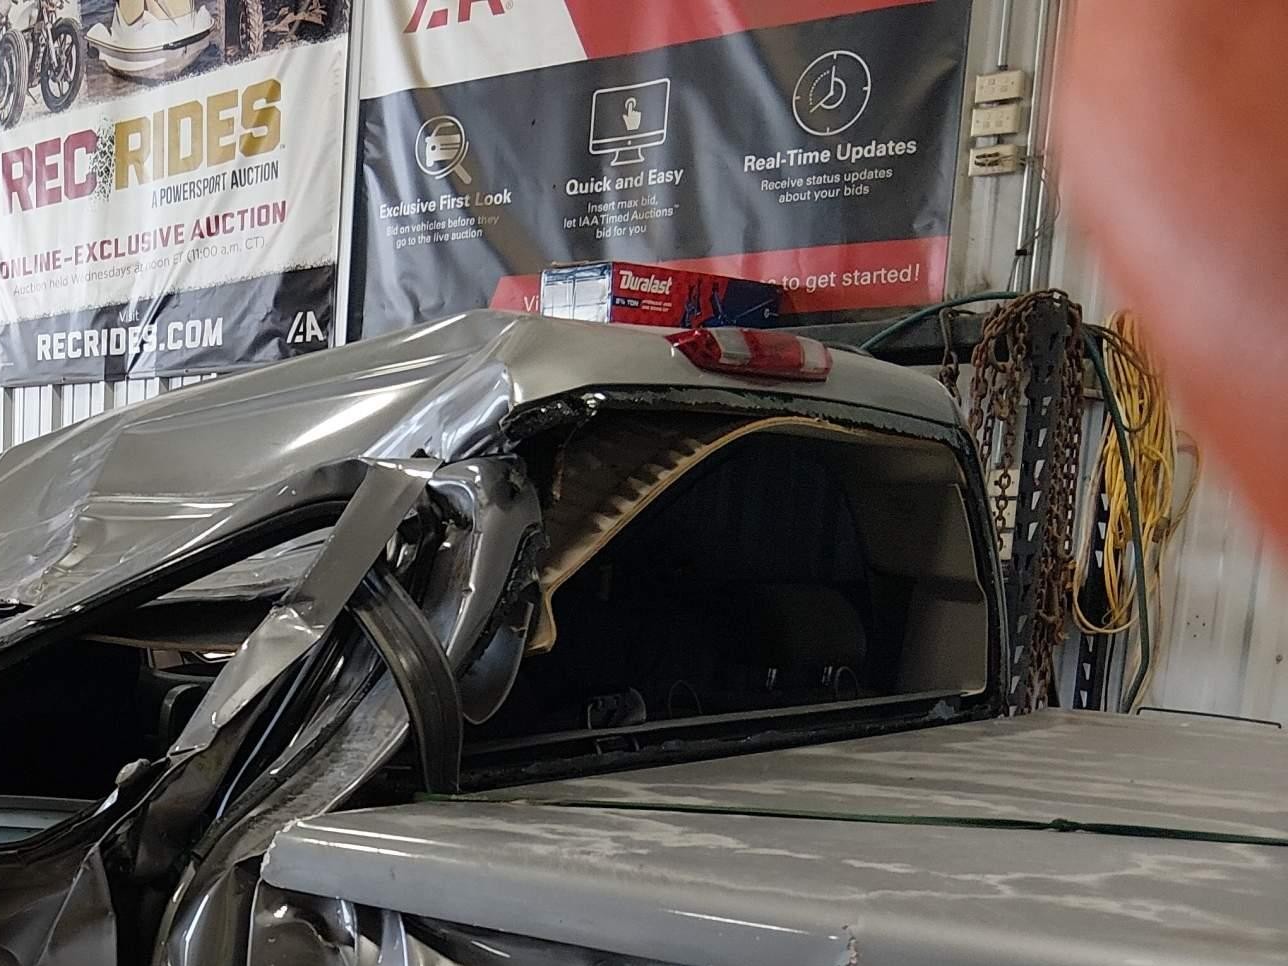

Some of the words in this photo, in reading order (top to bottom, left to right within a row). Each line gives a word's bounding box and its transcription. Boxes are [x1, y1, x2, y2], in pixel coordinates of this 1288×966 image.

[2, 129, 99, 214] REC
[115, 79, 282, 190] RIDES
[743, 148, 831, 173] Real-Time
[835, 139, 918, 164] Updates
[152, 190, 159, 208] A
[159, 172, 227, 207] POWERSPORT
[230, 160, 280, 189] AUCTION
[566, 175, 611, 196] Quick
[615, 171, 644, 190] and
[647, 168, 684, 186] Easy
[761, 176, 804, 192] Receive
[806, 172, 841, 186] status
[843, 167, 894, 184] updates
[379, 198, 436, 219] Exclusive
[439, 194, 471, 210] First
[475, 188, 512, 206] Look
[587, 201, 615, 213] Insert
[617, 199, 639, 210] max
[778, 190, 811, 204] about
[813, 187, 841, 202] your
[843, 184, 870, 197] bids
[411, 219, 446, 232] vehicles
[447, 216, 476, 228] before
[477, 214, 500, 227] they
[563, 217, 577, 229] let
[578, 215, 600, 227] IAA
[600, 211, 630, 225] Timed
[595, 227, 611, 239] bid
[613, 225, 627, 236] for
[628, 224, 647, 238] you
[0, 223, 185, 280] ONLINE-EXCLUSIVE
[190, 200, 287, 241] AUCTION
[245, 236, 265, 250] CT)
[396, 238, 407, 249] go
[408, 235, 417, 246] to
[418, 233, 431, 244] the
[433, 231, 449, 242] live
[451, 227, 483, 240] auction
[618, 269, 673, 295] Duralast
[782, 275, 800, 290] to
[806, 271, 837, 293] get
[841, 263, 920, 286] started!
[119, 310, 140, 323] Visit
[37, 317, 224, 361] RECRIDES.COM
